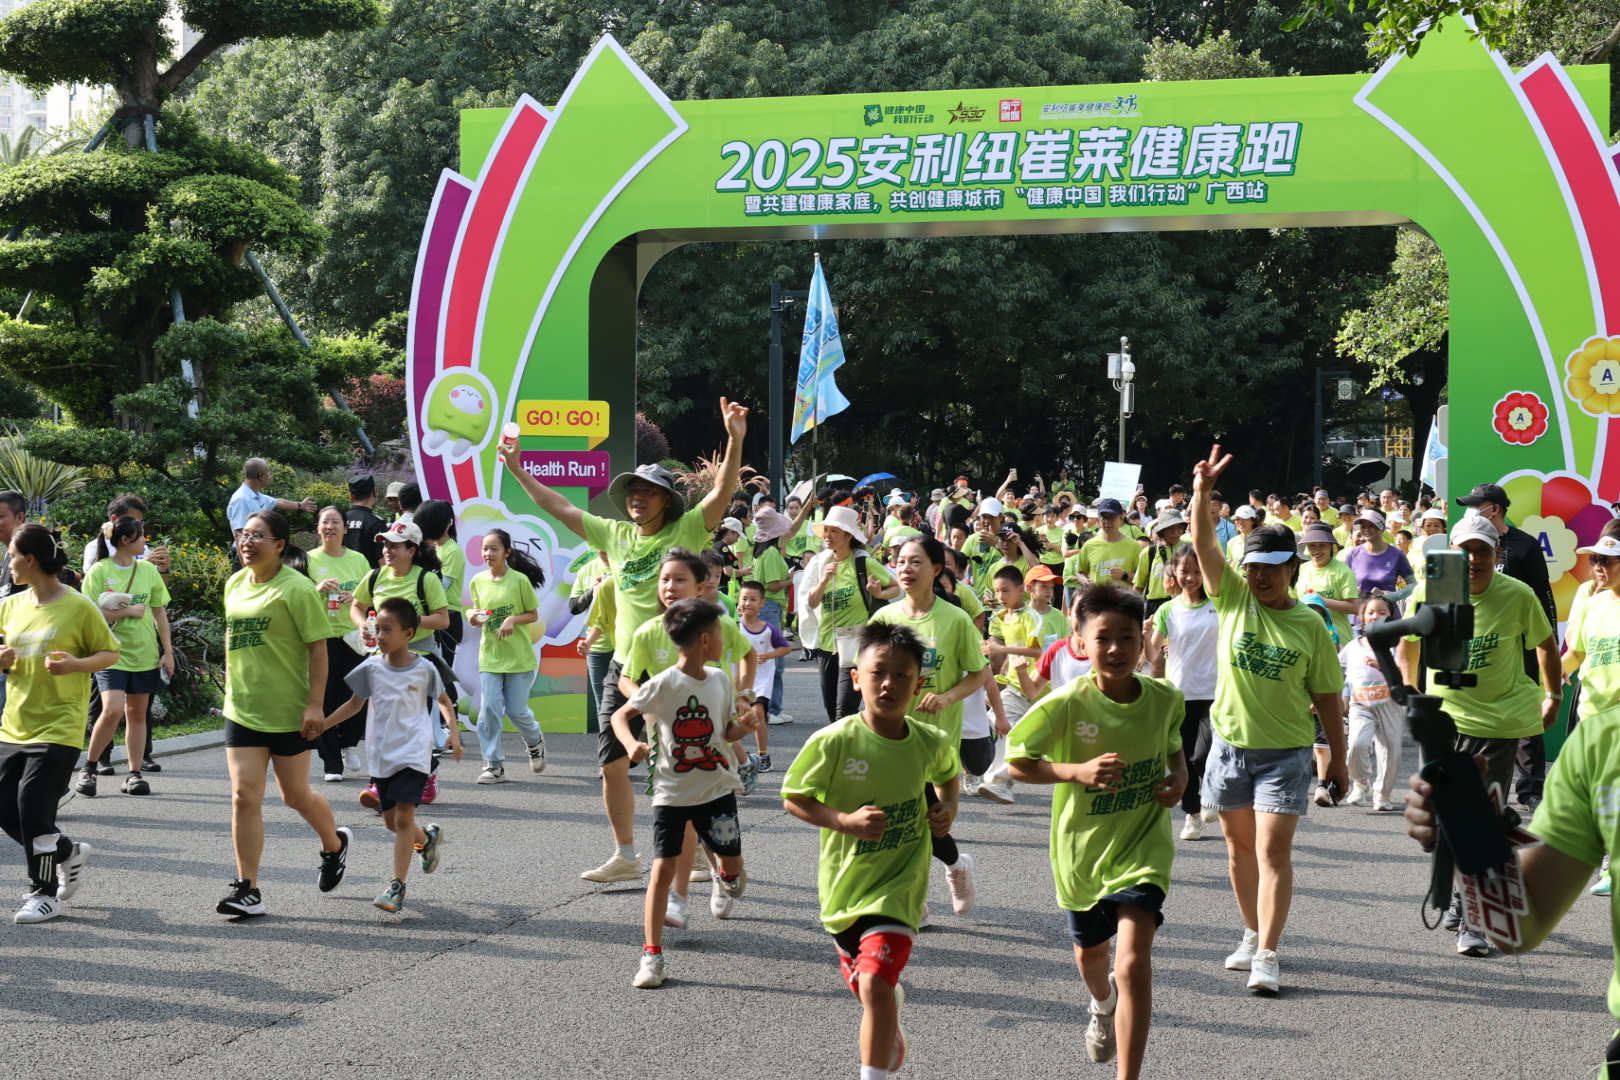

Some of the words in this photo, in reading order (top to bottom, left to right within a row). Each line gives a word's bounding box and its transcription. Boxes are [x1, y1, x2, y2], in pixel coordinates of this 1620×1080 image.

[884, 104, 926, 116] 健康中国
[893, 114, 934, 124] 我们行动
[715, 121, 1303, 192] 2025安利纽崔莱健康跑
[523, 461, 565, 476] Health
[1074, 721, 1099, 737] 30
[842, 757, 869, 774] 30
